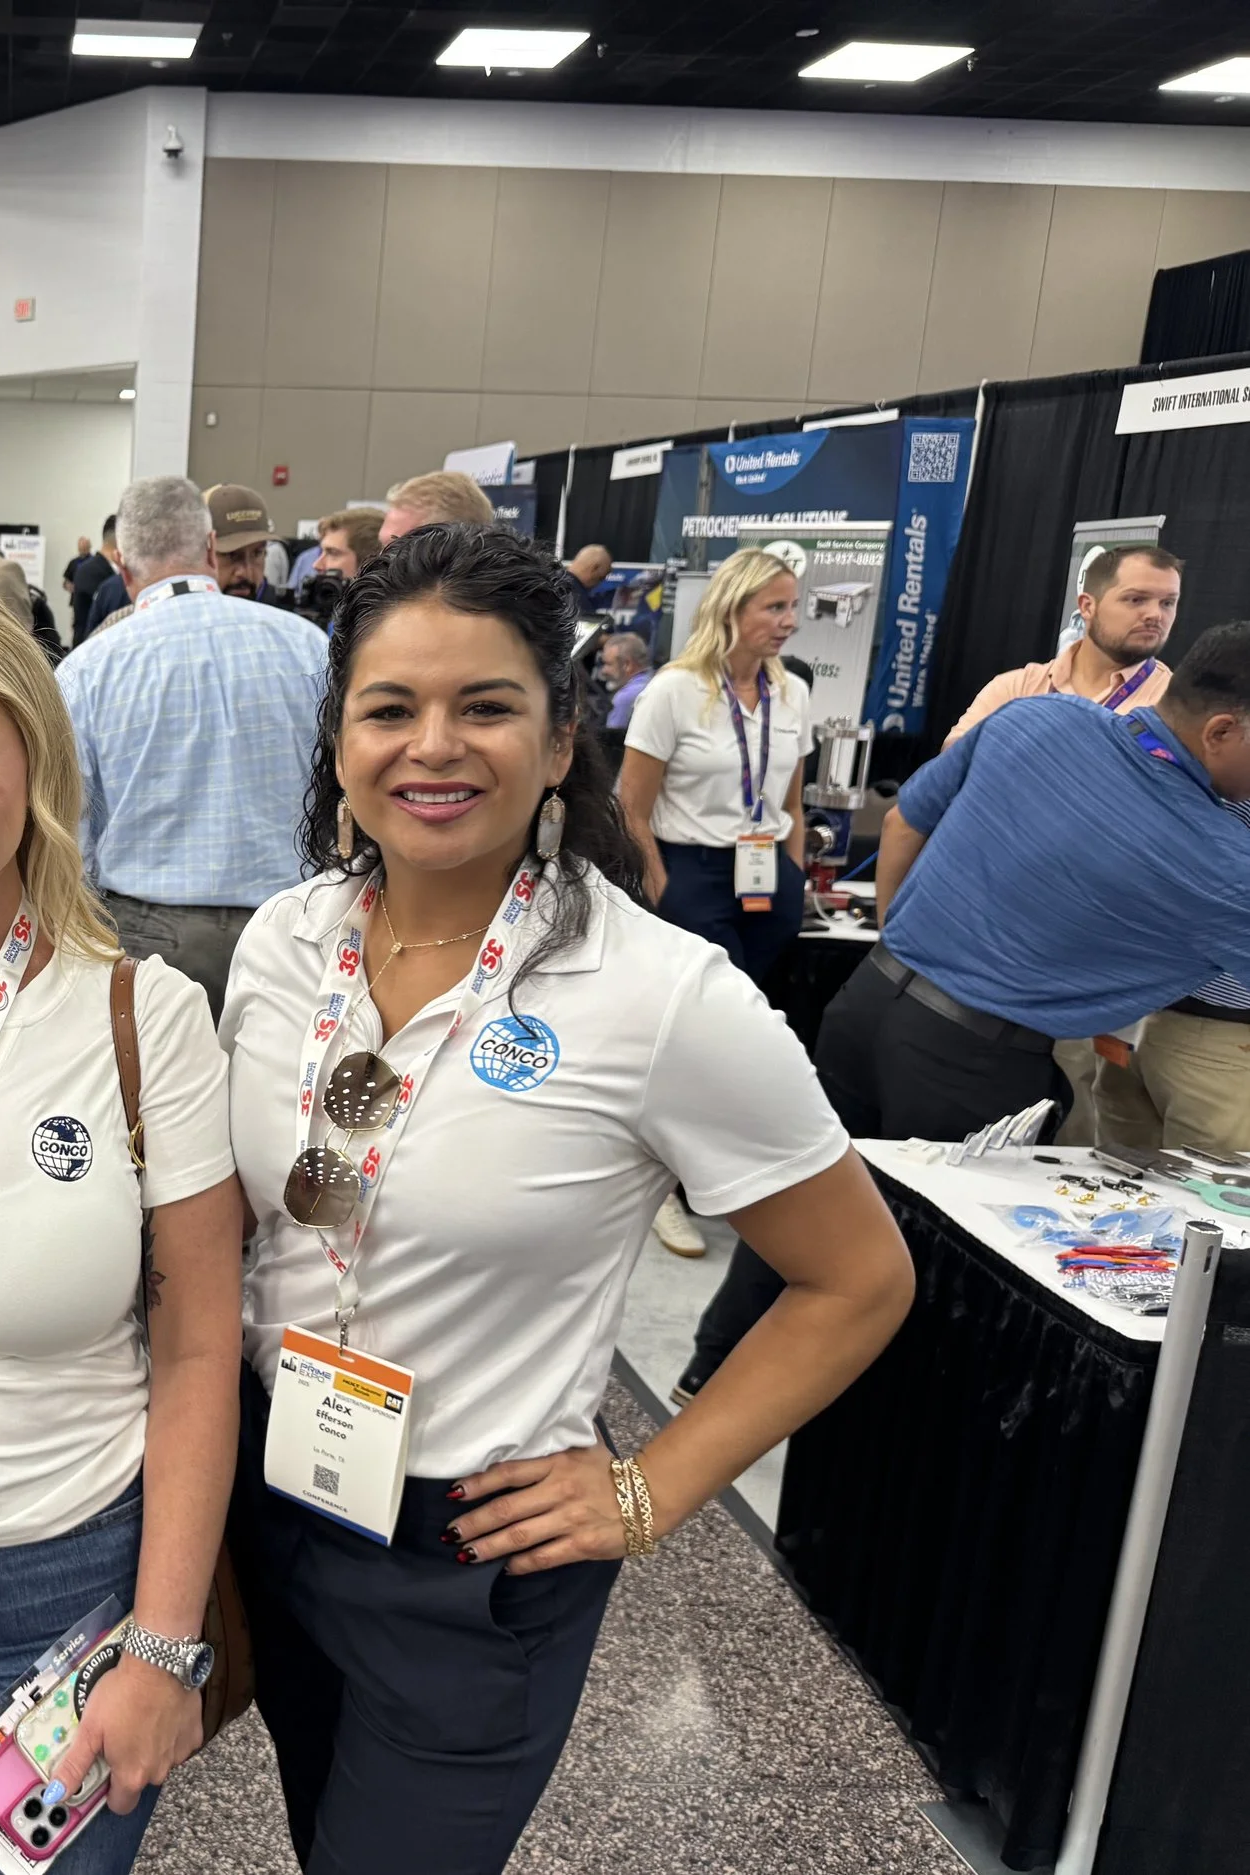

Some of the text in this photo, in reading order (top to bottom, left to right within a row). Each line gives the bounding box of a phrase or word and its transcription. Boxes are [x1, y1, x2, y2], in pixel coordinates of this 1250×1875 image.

[1152, 395, 1178, 413] SWIFT
[1178, 387, 1240, 410] INTERNATIONAL
[736, 448, 801, 472] United Rentals
[887, 513, 928, 708] United Rentals
[515, 871, 535, 902] 3S
[14, 914, 31, 943] 3S
[339, 948, 360, 977] 3S
[481, 938, 504, 970] 3S
[315, 1018, 337, 1042] 3S
[480, 1039, 548, 1069] CONCO
[301, 1089, 312, 1117] 3S
[39, 1140, 88, 1157] CONCO
[363, 1146, 381, 1179] 3S
[299, 1369, 325, 1384] EXPO
[300, 1363, 332, 1380] PRIME
[316, 1409, 354, 1430] Efferson
[322, 1396, 352, 1416] Alex
[335, 1393, 397, 1420] REGISTRATION SPONSOR
[318, 1422, 347, 1440] Conco
[302, 1489, 348, 1513] CONFERENCE
[53, 1633, 86, 1666] Service
[78, 1648, 114, 1713] GUIDED TAS
